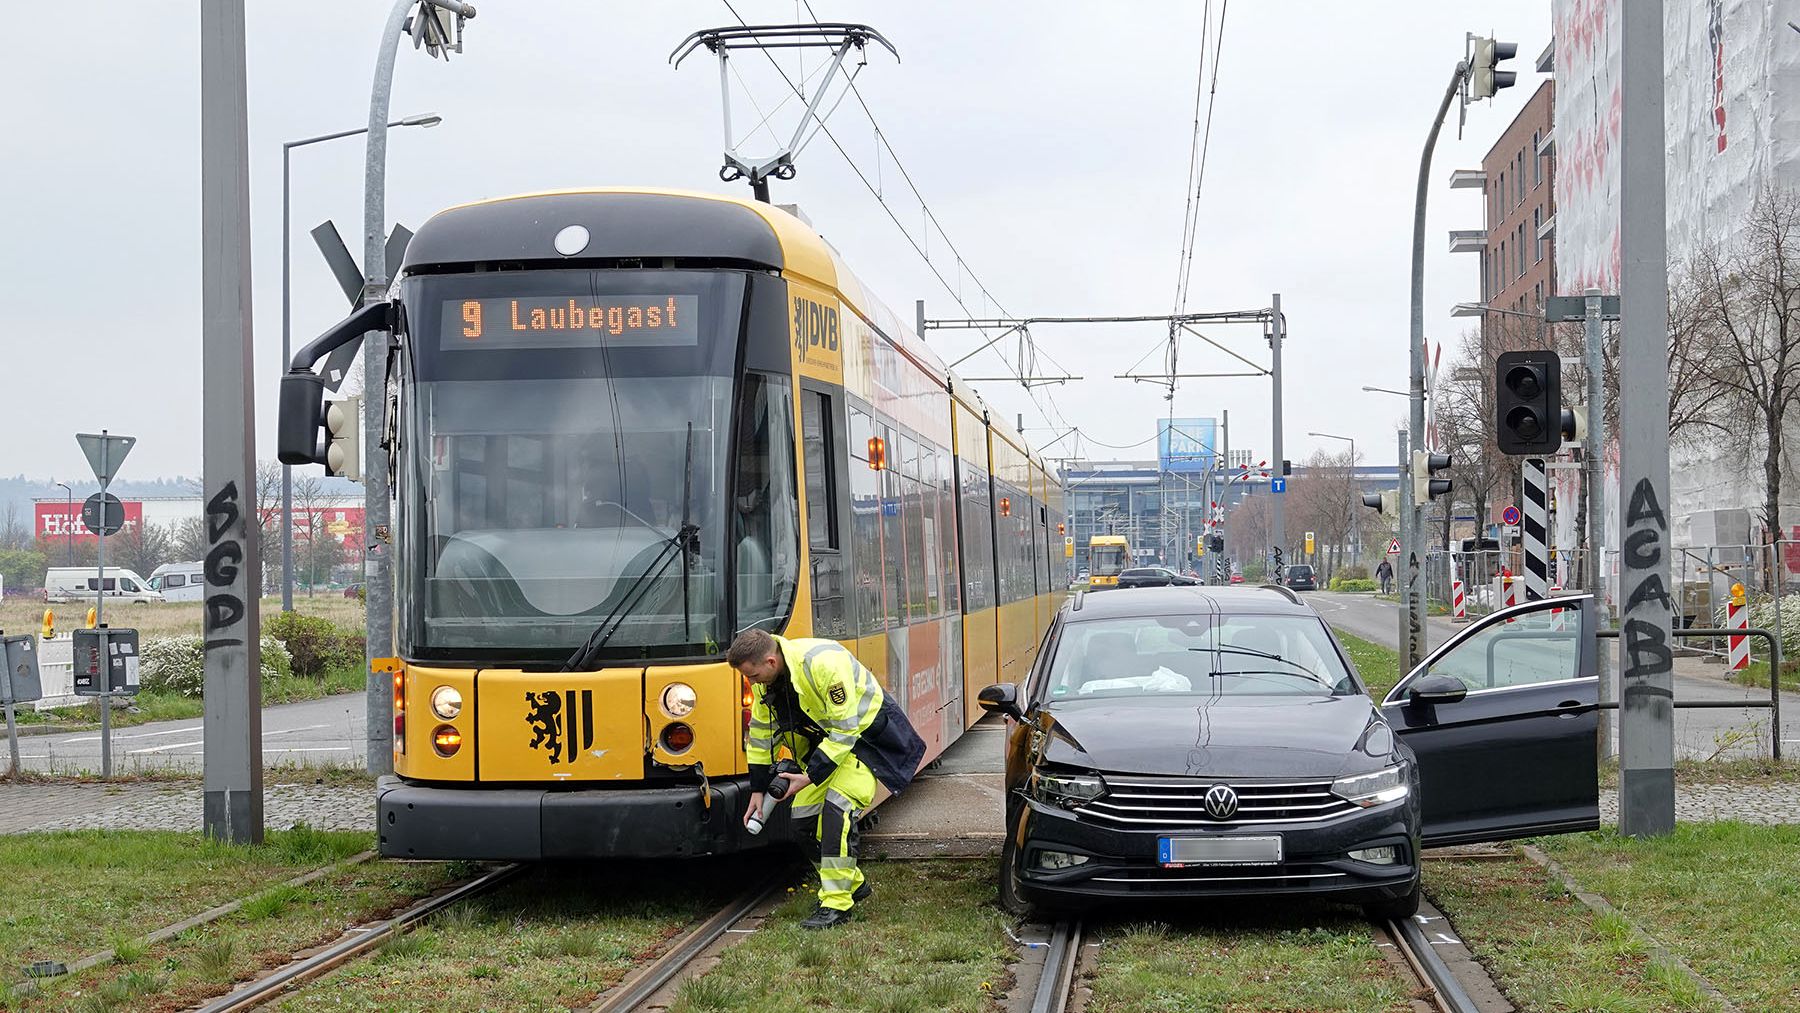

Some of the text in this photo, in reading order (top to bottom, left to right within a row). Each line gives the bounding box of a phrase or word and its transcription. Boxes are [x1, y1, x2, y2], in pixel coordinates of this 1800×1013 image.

[462, 297, 677, 337] 9 Laubegast
[809, 301, 838, 352] DVB
[1273, 480, 1283, 491] T
[203, 480, 244, 630] SGD
[1624, 477, 1673, 679] ACAB
